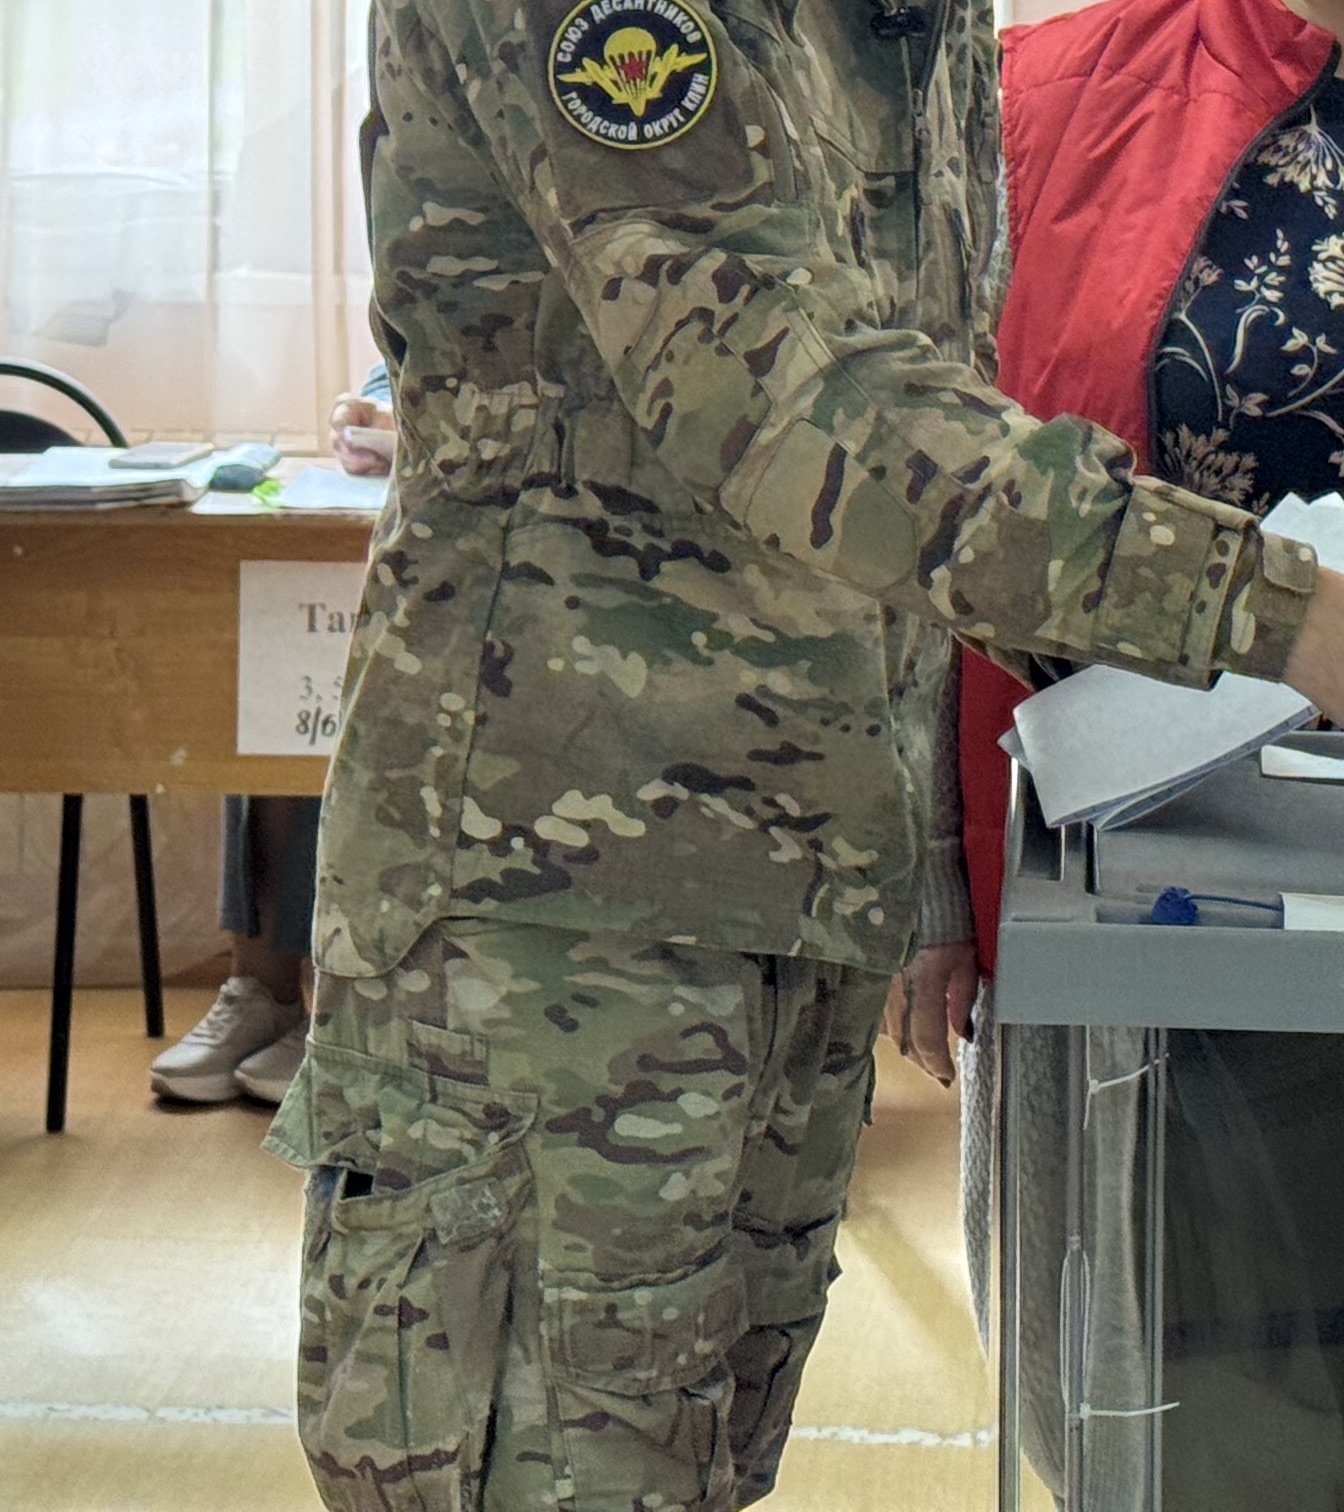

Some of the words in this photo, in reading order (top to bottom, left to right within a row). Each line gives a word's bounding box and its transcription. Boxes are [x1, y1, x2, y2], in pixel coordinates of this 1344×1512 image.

[557, 17, 590, 63] СОЮЗ
[561, 91, 638, 141] ГОРОДСКОЙ
[643, 107, 686, 138] ОКРУГ
[681, 73, 709, 112] КЛИН
[298, 601, 356, 634] Та
